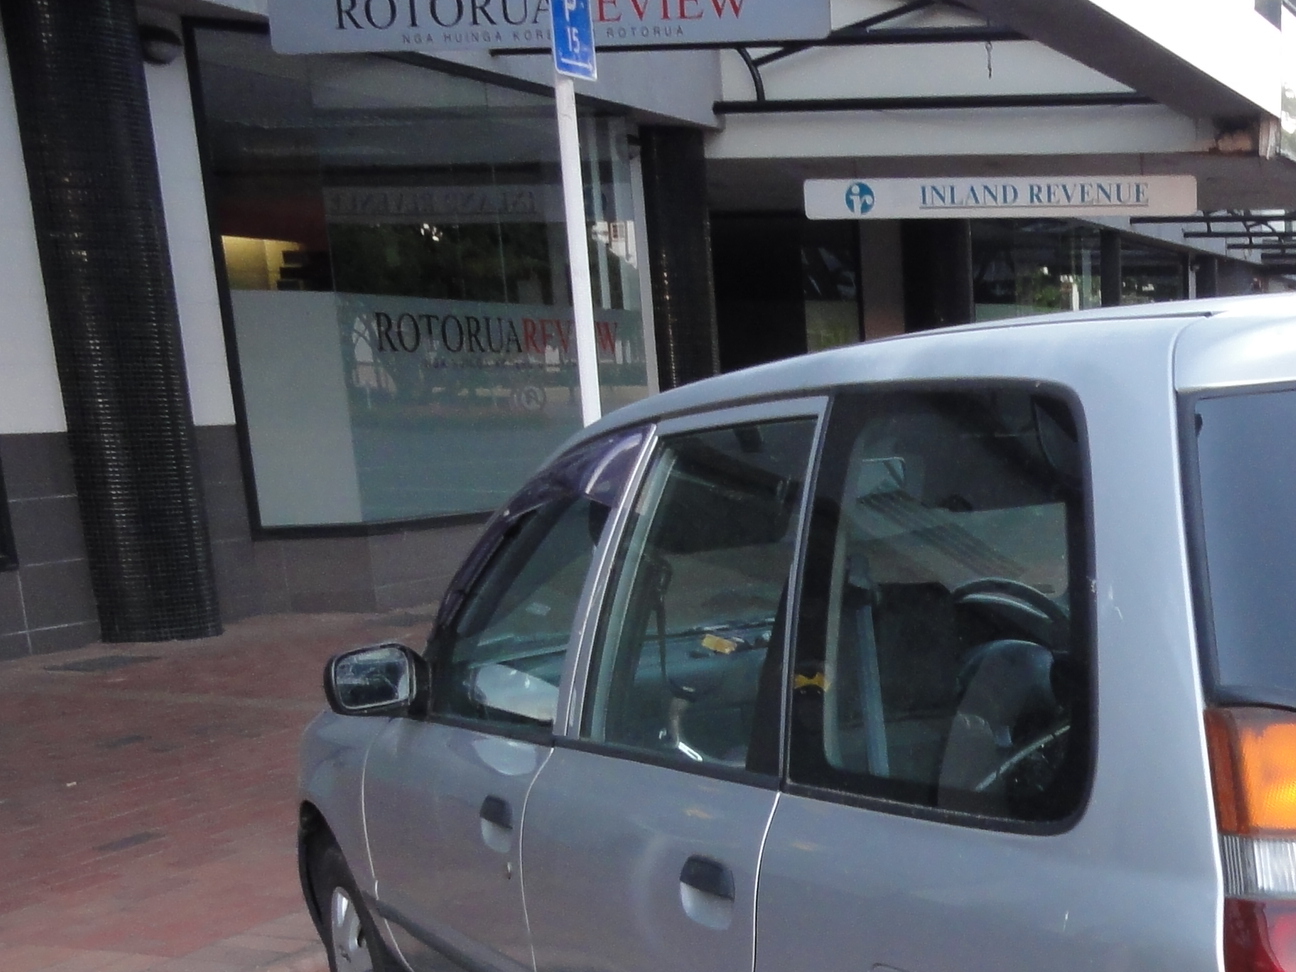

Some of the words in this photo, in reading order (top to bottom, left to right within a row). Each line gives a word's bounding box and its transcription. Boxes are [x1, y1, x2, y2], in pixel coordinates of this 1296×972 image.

[592, 0, 746, 22] EVIEW
[402, 33, 434, 45] NGA
[443, 31, 502, 44] HUINGA
[606, 25, 685, 38] ROTORUA
[566, 26, 581, 54] 15
[919, 184, 1019, 206] INLAND
[1028, 181, 1150, 205] REVENUE
